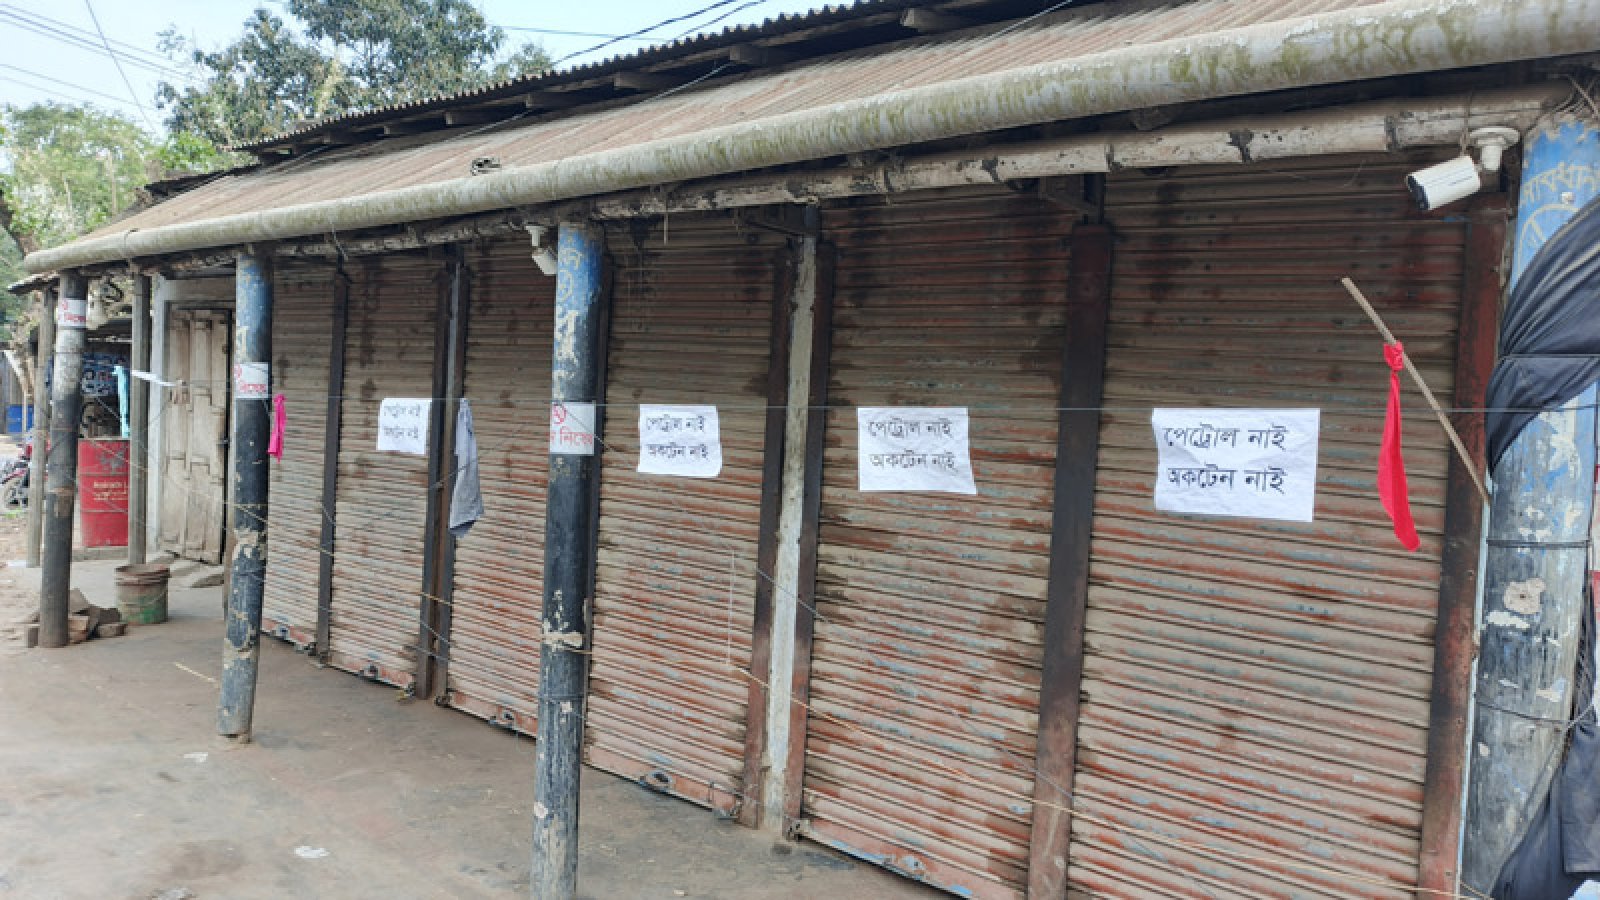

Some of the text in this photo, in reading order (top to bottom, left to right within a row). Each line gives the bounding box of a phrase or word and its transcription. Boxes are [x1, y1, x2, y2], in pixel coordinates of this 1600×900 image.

[646, 413, 706, 433] পেট্রোল নাই
[867, 415, 954, 439] পেট্রোল নাই
[1162, 421, 1289, 451] পেট্রোল নাই
[868, 448, 959, 474] অকটেন নাই
[1167, 461, 1288, 495] অকটেন নাই
